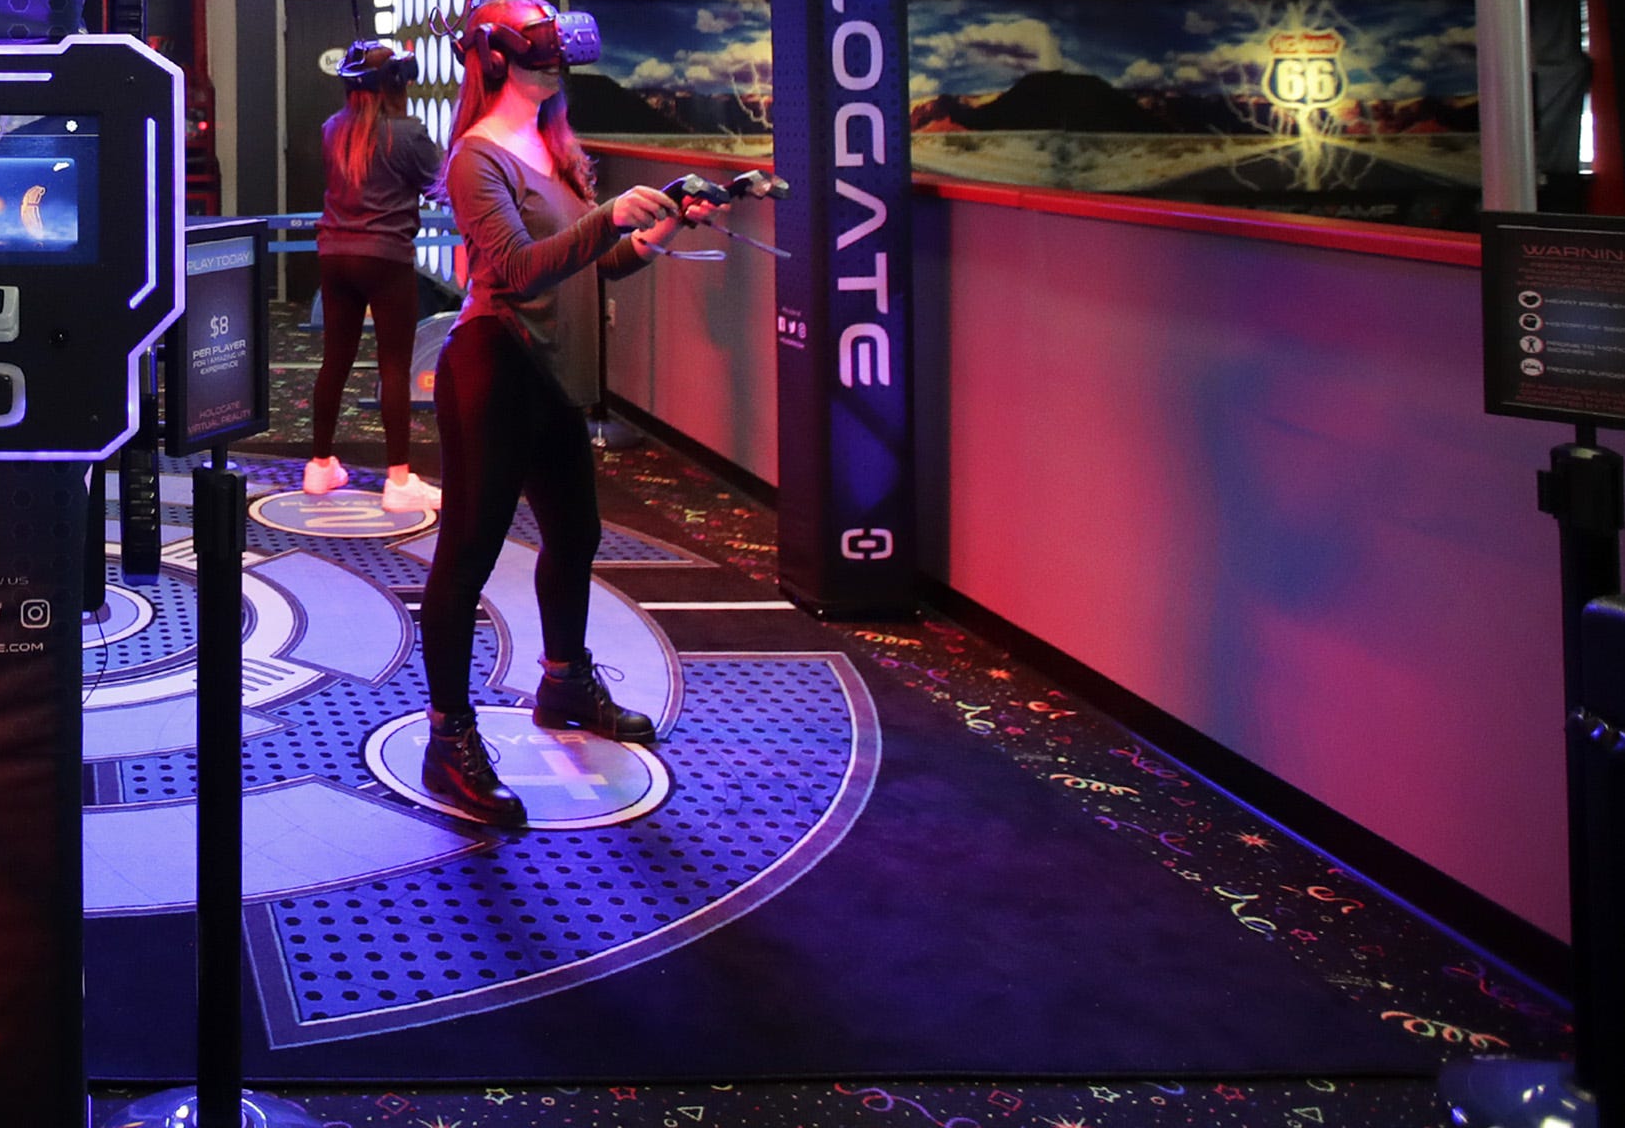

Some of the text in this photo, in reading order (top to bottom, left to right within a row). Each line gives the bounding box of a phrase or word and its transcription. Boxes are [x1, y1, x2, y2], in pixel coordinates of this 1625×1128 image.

[1276, 59, 1338, 101] 66
[187, 251, 251, 271] PLAY TODAY
[1522, 244, 1625, 261] WARNIN
[210, 315, 229, 338] $8
[193, 340, 246, 360] PER PLAYER
[193, 359, 206, 368] FOR
[7, 576, 29, 585] US
